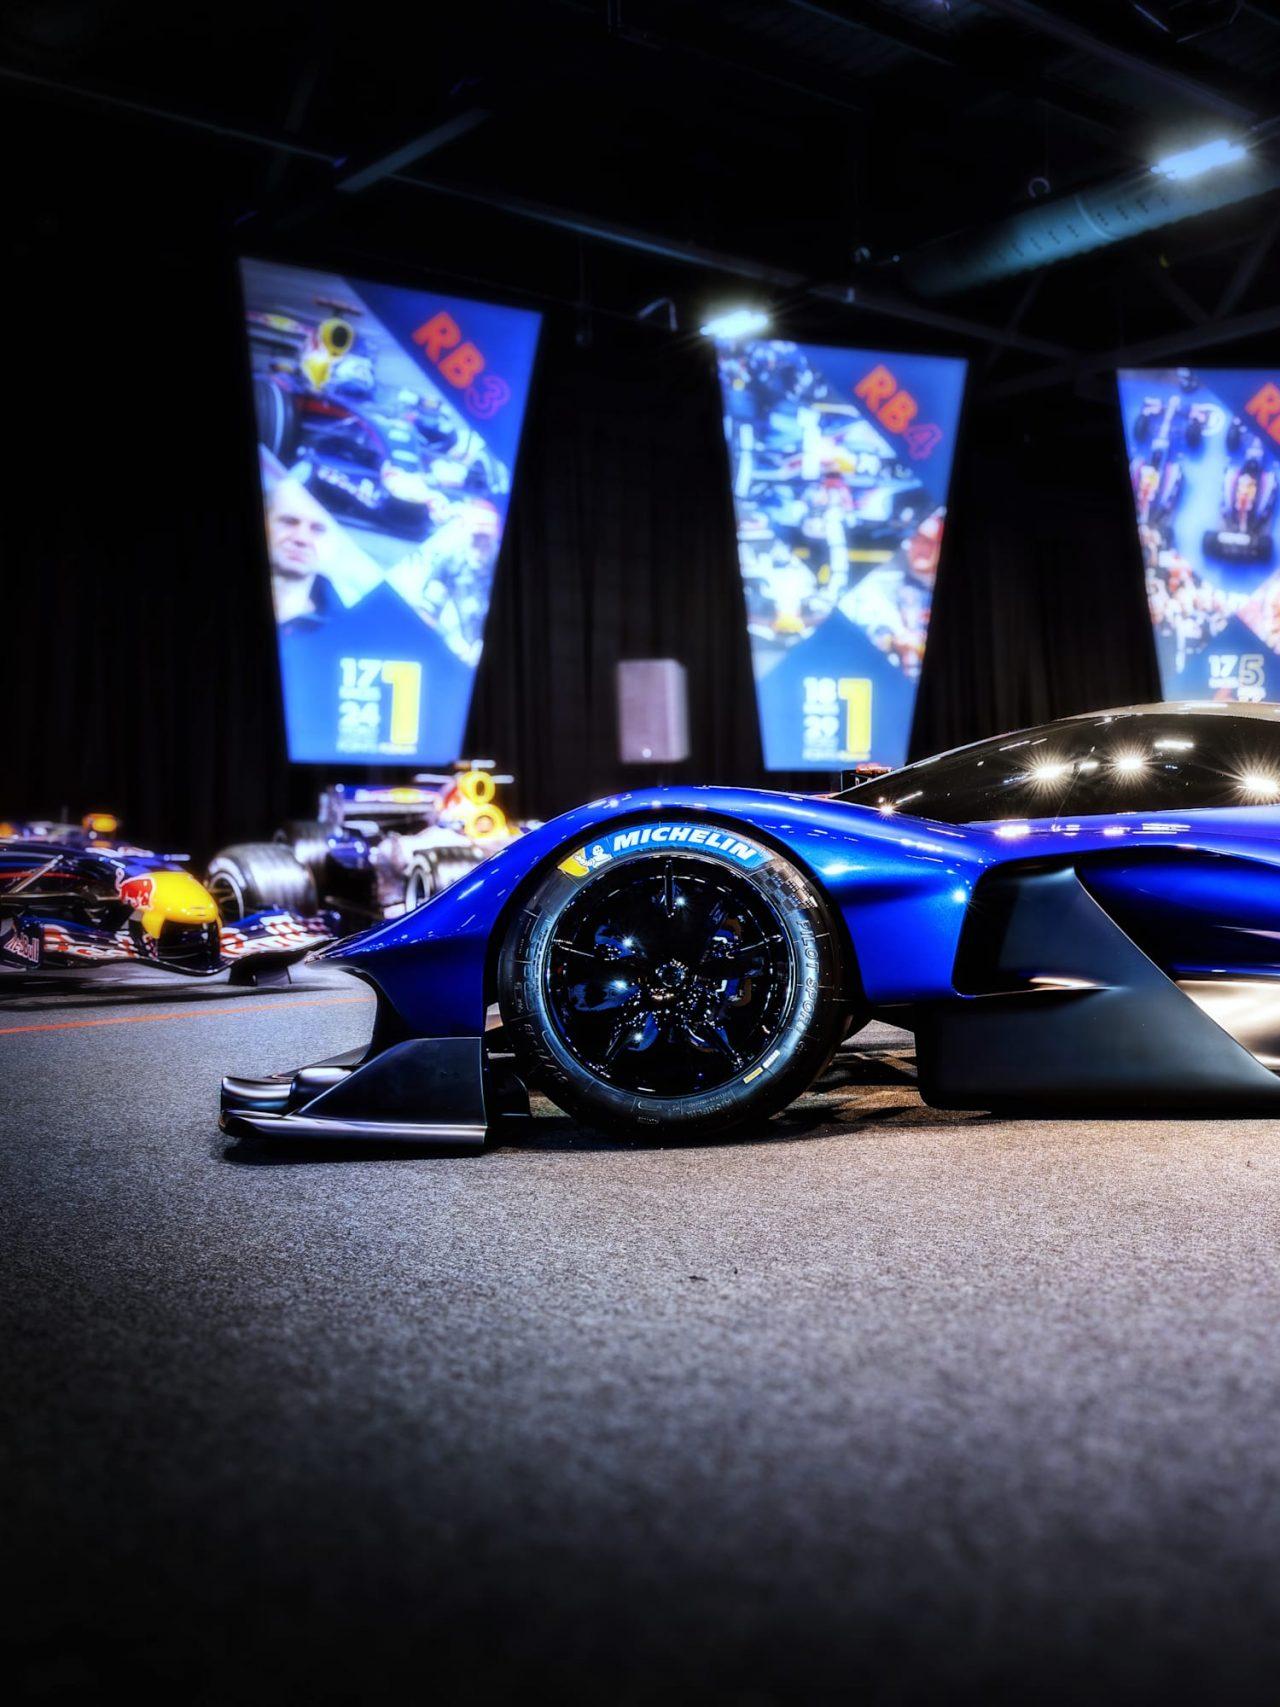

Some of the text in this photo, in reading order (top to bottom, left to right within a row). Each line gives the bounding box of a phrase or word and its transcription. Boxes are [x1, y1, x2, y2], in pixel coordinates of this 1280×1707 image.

[411, 311, 512, 420] RB3
[854, 364, 943, 461] RB4
[340, 657, 382, 688] 17
[381, 660, 422, 744] 1
[1208, 654, 1238, 678] 17
[838, 678, 872, 752] 1
[613, 826, 757, 860] MICHELIN
[793, 919, 820, 1033] PILOT SPORT
